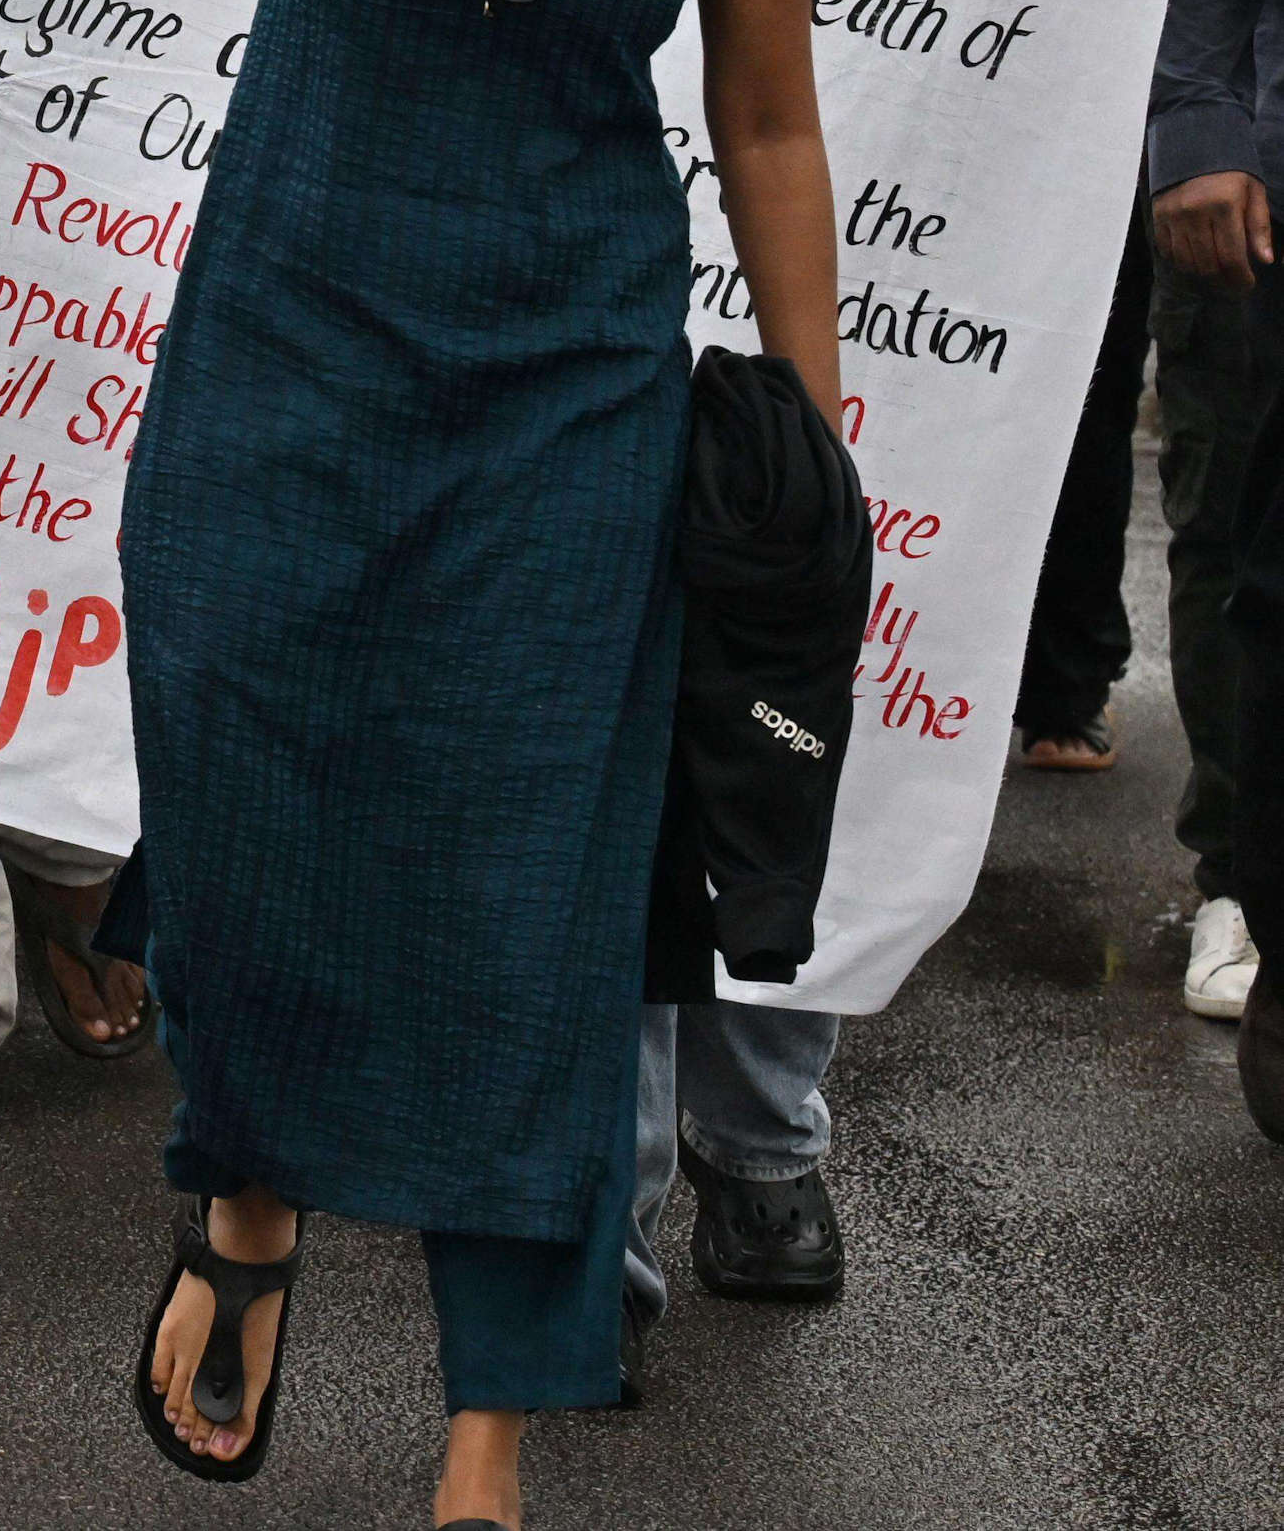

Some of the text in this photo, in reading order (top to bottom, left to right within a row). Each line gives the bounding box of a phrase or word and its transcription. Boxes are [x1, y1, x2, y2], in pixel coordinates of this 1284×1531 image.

[960, 5, 1039, 80] of
[34, 75, 108, 141] of
[138, 93, 221, 170] Ou
[845, 178, 947, 256] the
[751, 699, 826, 760] adidas
[880, 667, 976, 740] the
